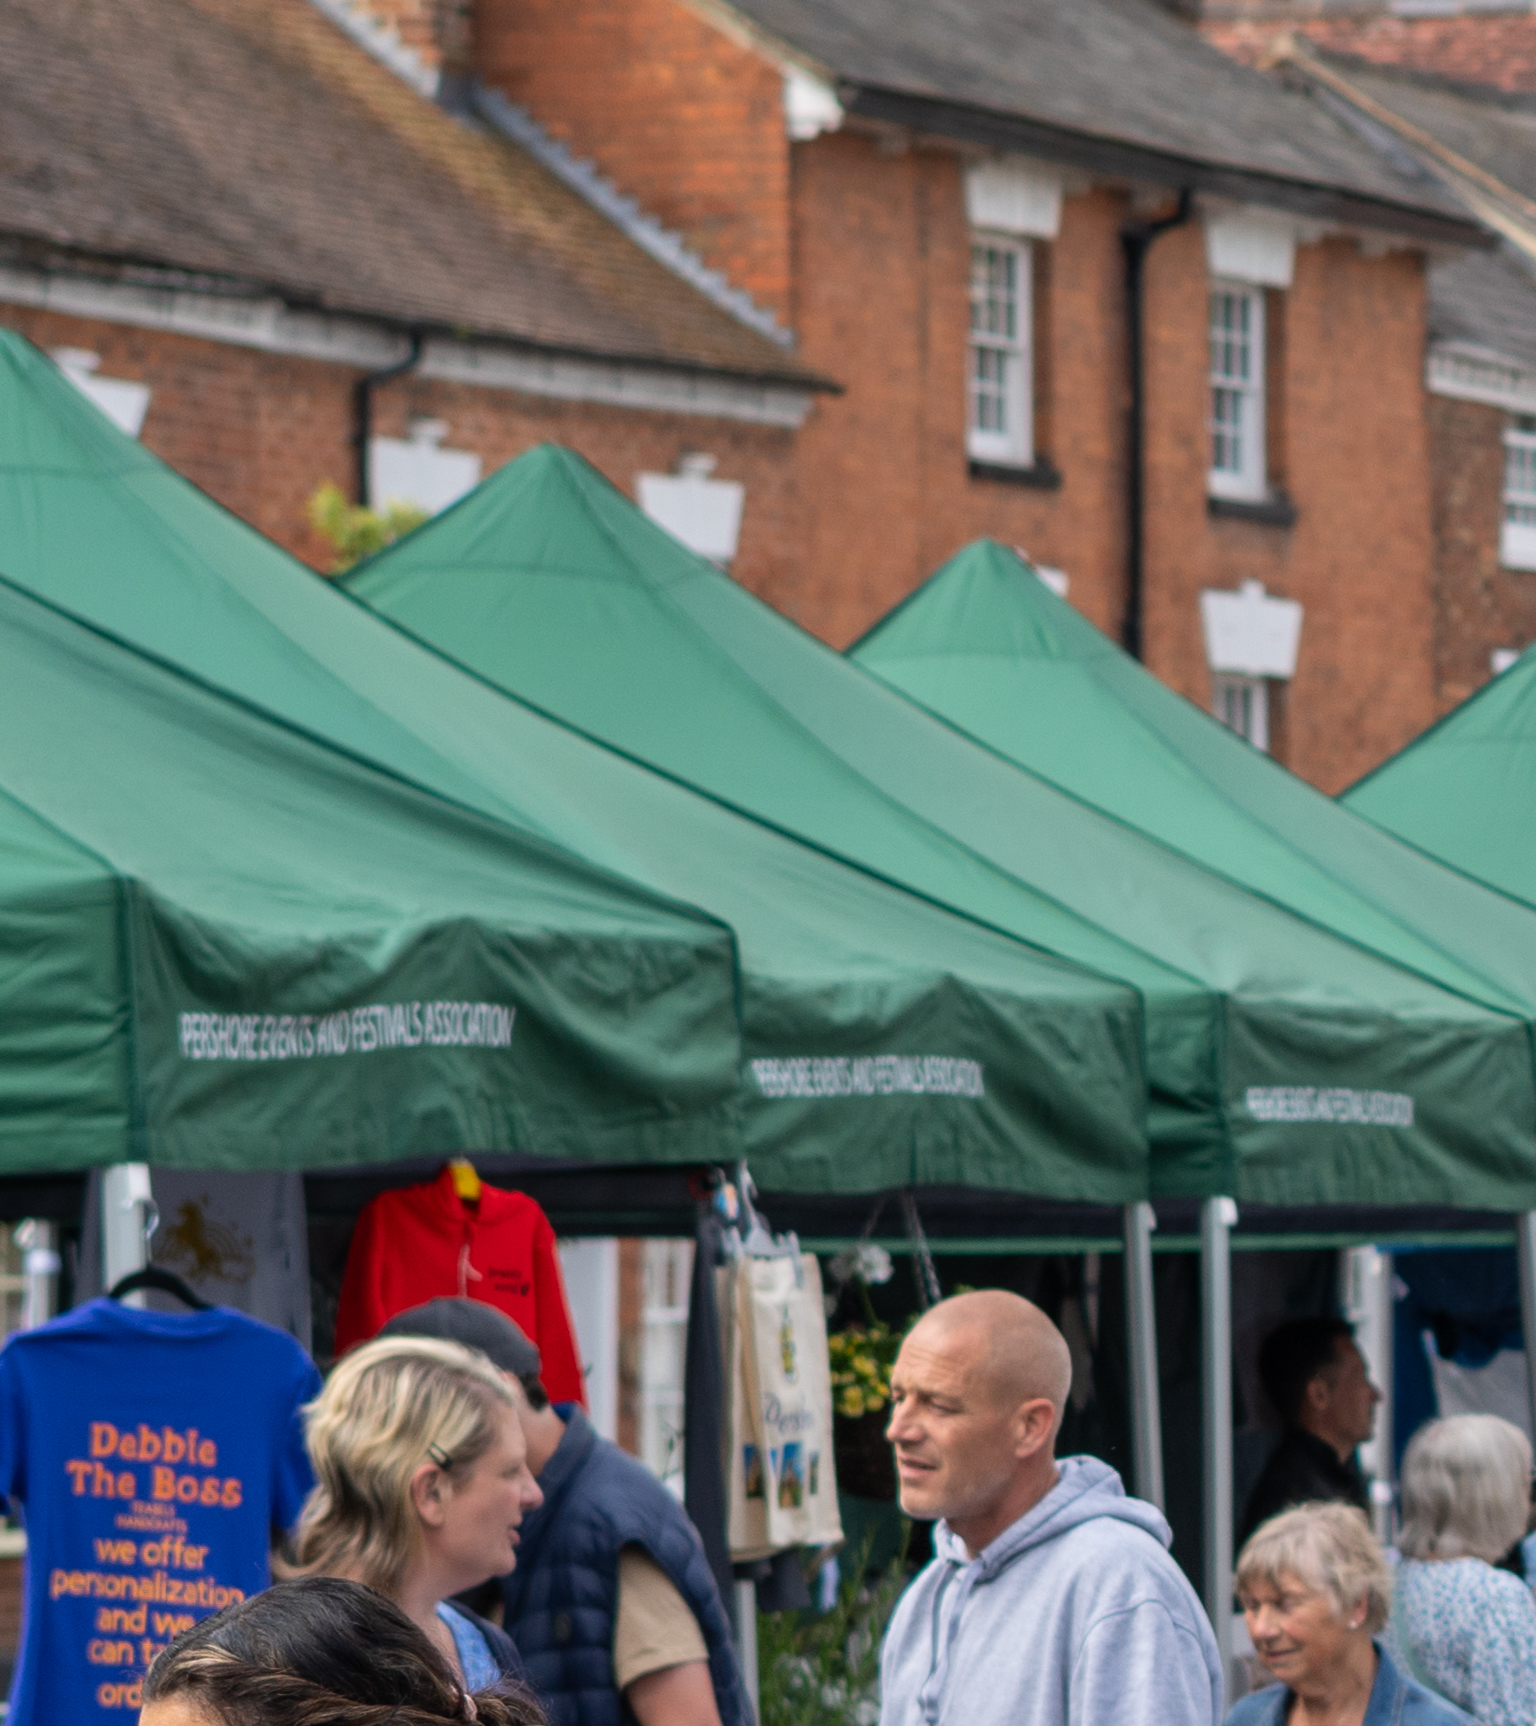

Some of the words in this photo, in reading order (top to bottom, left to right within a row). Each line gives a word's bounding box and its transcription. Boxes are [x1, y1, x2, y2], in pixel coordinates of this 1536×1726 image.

[181, 1011, 258, 1060] PERSHORE
[259, 1014, 315, 1060] EVENTS
[316, 1010, 349, 1056] AND
[351, 1002, 422, 1052] FESTIVALS
[423, 1000, 517, 1047] ASSOCIATION
[67, 1459, 136, 1499] The
[151, 1465, 243, 1508] Boss
[95, 1538, 135, 1564] we
[141, 1536, 209, 1571] offer
[50, 1567, 245, 1607] personalization
[96, 1603, 146, 1634] and
[87, 1638, 134, 1665] can
